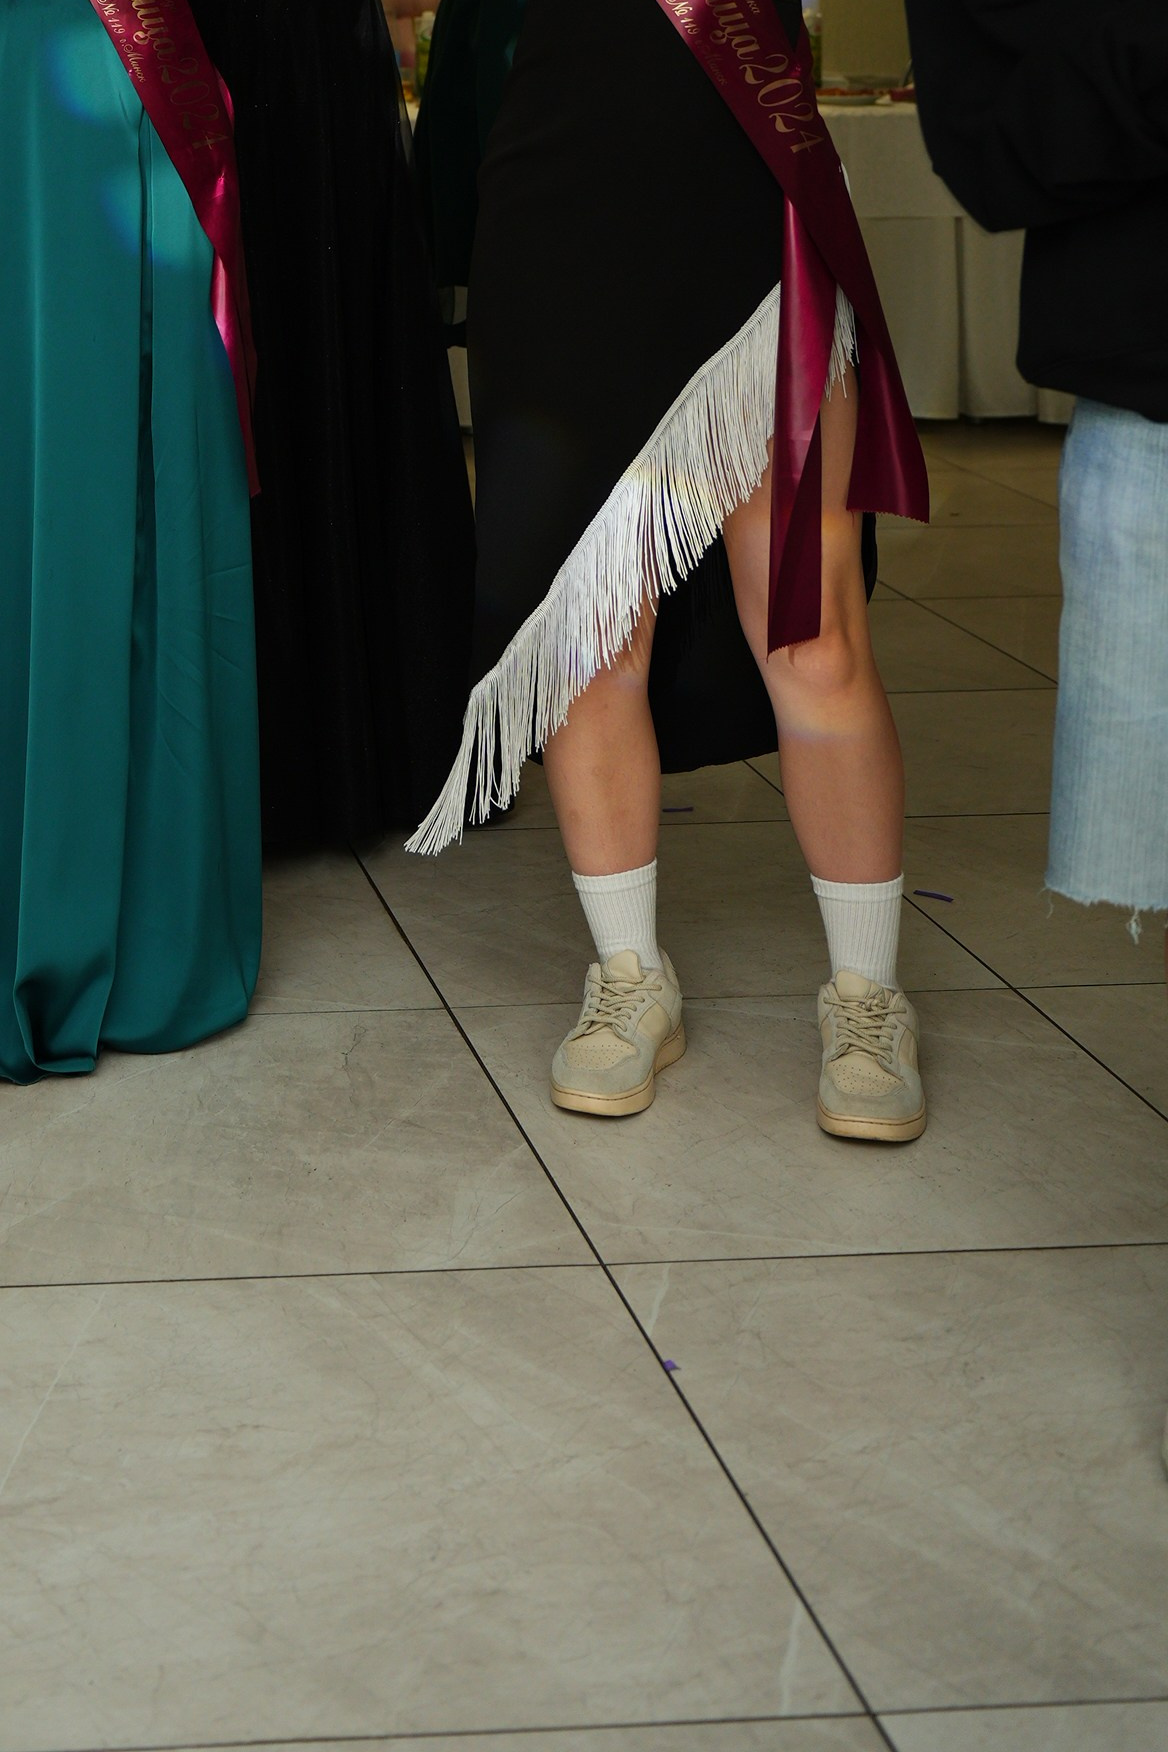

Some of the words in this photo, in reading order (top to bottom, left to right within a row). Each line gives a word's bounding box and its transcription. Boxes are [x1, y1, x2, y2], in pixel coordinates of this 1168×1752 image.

[108, 18, 125, 34] 119
[681, 16, 700, 35] 119
[158, 56, 229, 150] 2024
[738, 53, 824, 154] 2024
